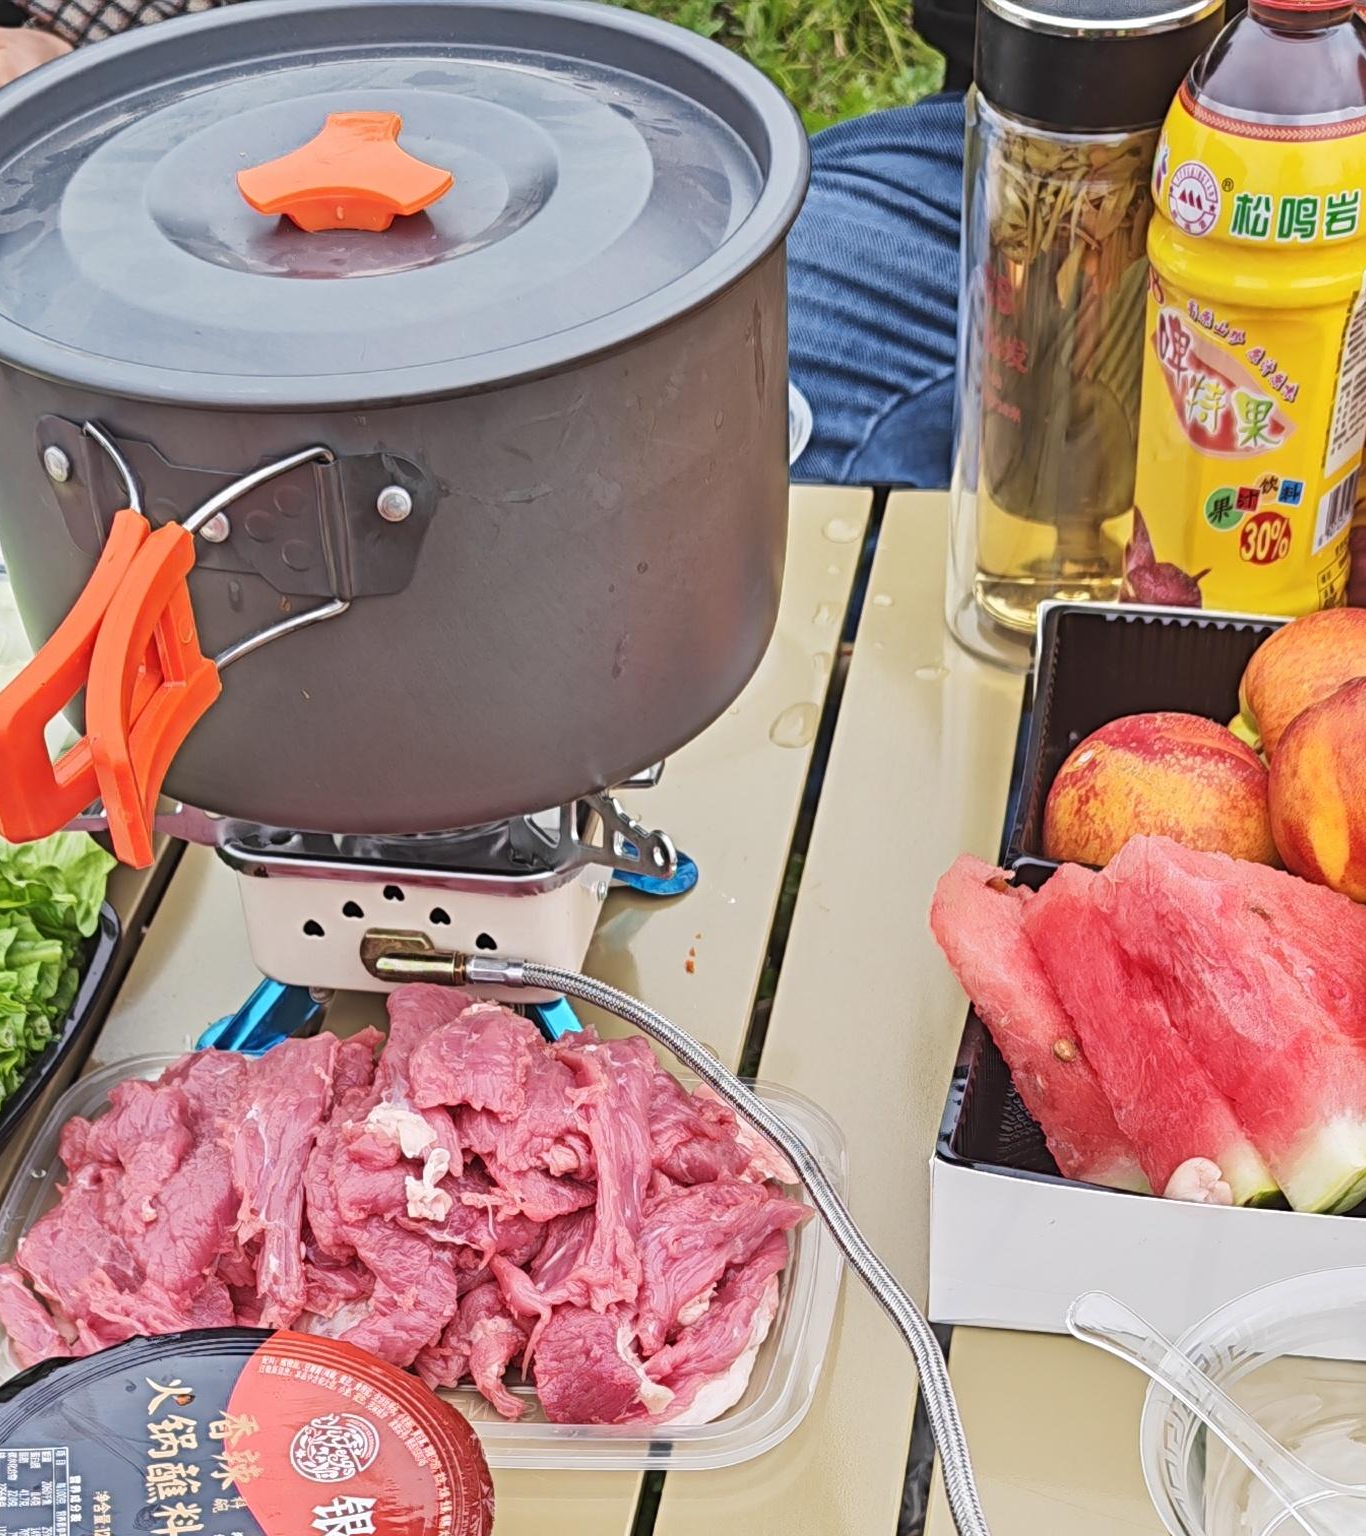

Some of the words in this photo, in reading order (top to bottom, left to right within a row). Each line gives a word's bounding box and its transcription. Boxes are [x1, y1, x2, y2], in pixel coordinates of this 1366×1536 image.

[1232, 192, 1360, 241] 松鸣岩
[1158, 312, 1283, 449] 啤特果
[1208, 476, 1302, 522] 果汁饮料
[1241, 517, 1290, 561] 30%
[208, 1410, 265, 1491] 香辣
